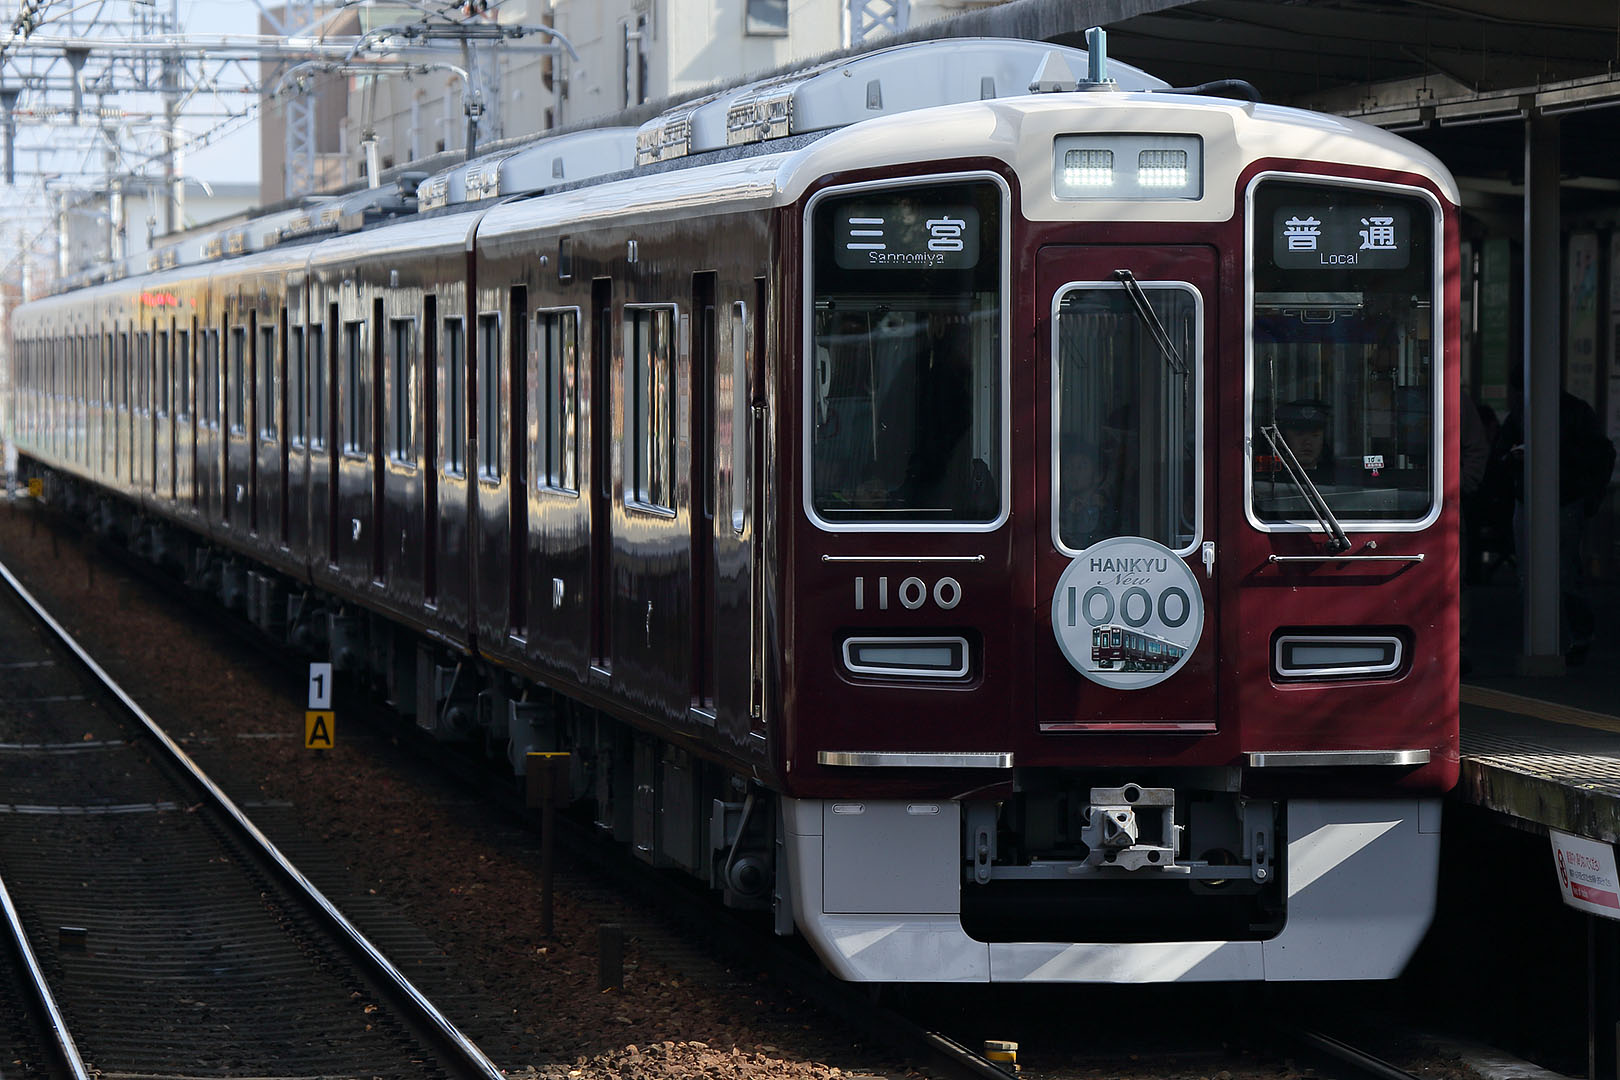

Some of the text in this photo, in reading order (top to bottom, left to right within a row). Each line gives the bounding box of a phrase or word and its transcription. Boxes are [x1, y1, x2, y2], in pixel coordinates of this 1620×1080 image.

[846, 215, 966, 251] 三宮
[1283, 216, 1398, 251] 普通
[868, 251, 945, 266] Sannomiya
[1320, 252, 1358, 265] Local
[1089, 558, 1168, 573] HANKYU
[1096, 572, 1153, 586] New
[855, 576, 962, 610] 1100
[1067, 586, 1191, 628] 1000
[311, 673, 324, 700] 1
[308, 715, 332, 746] A
